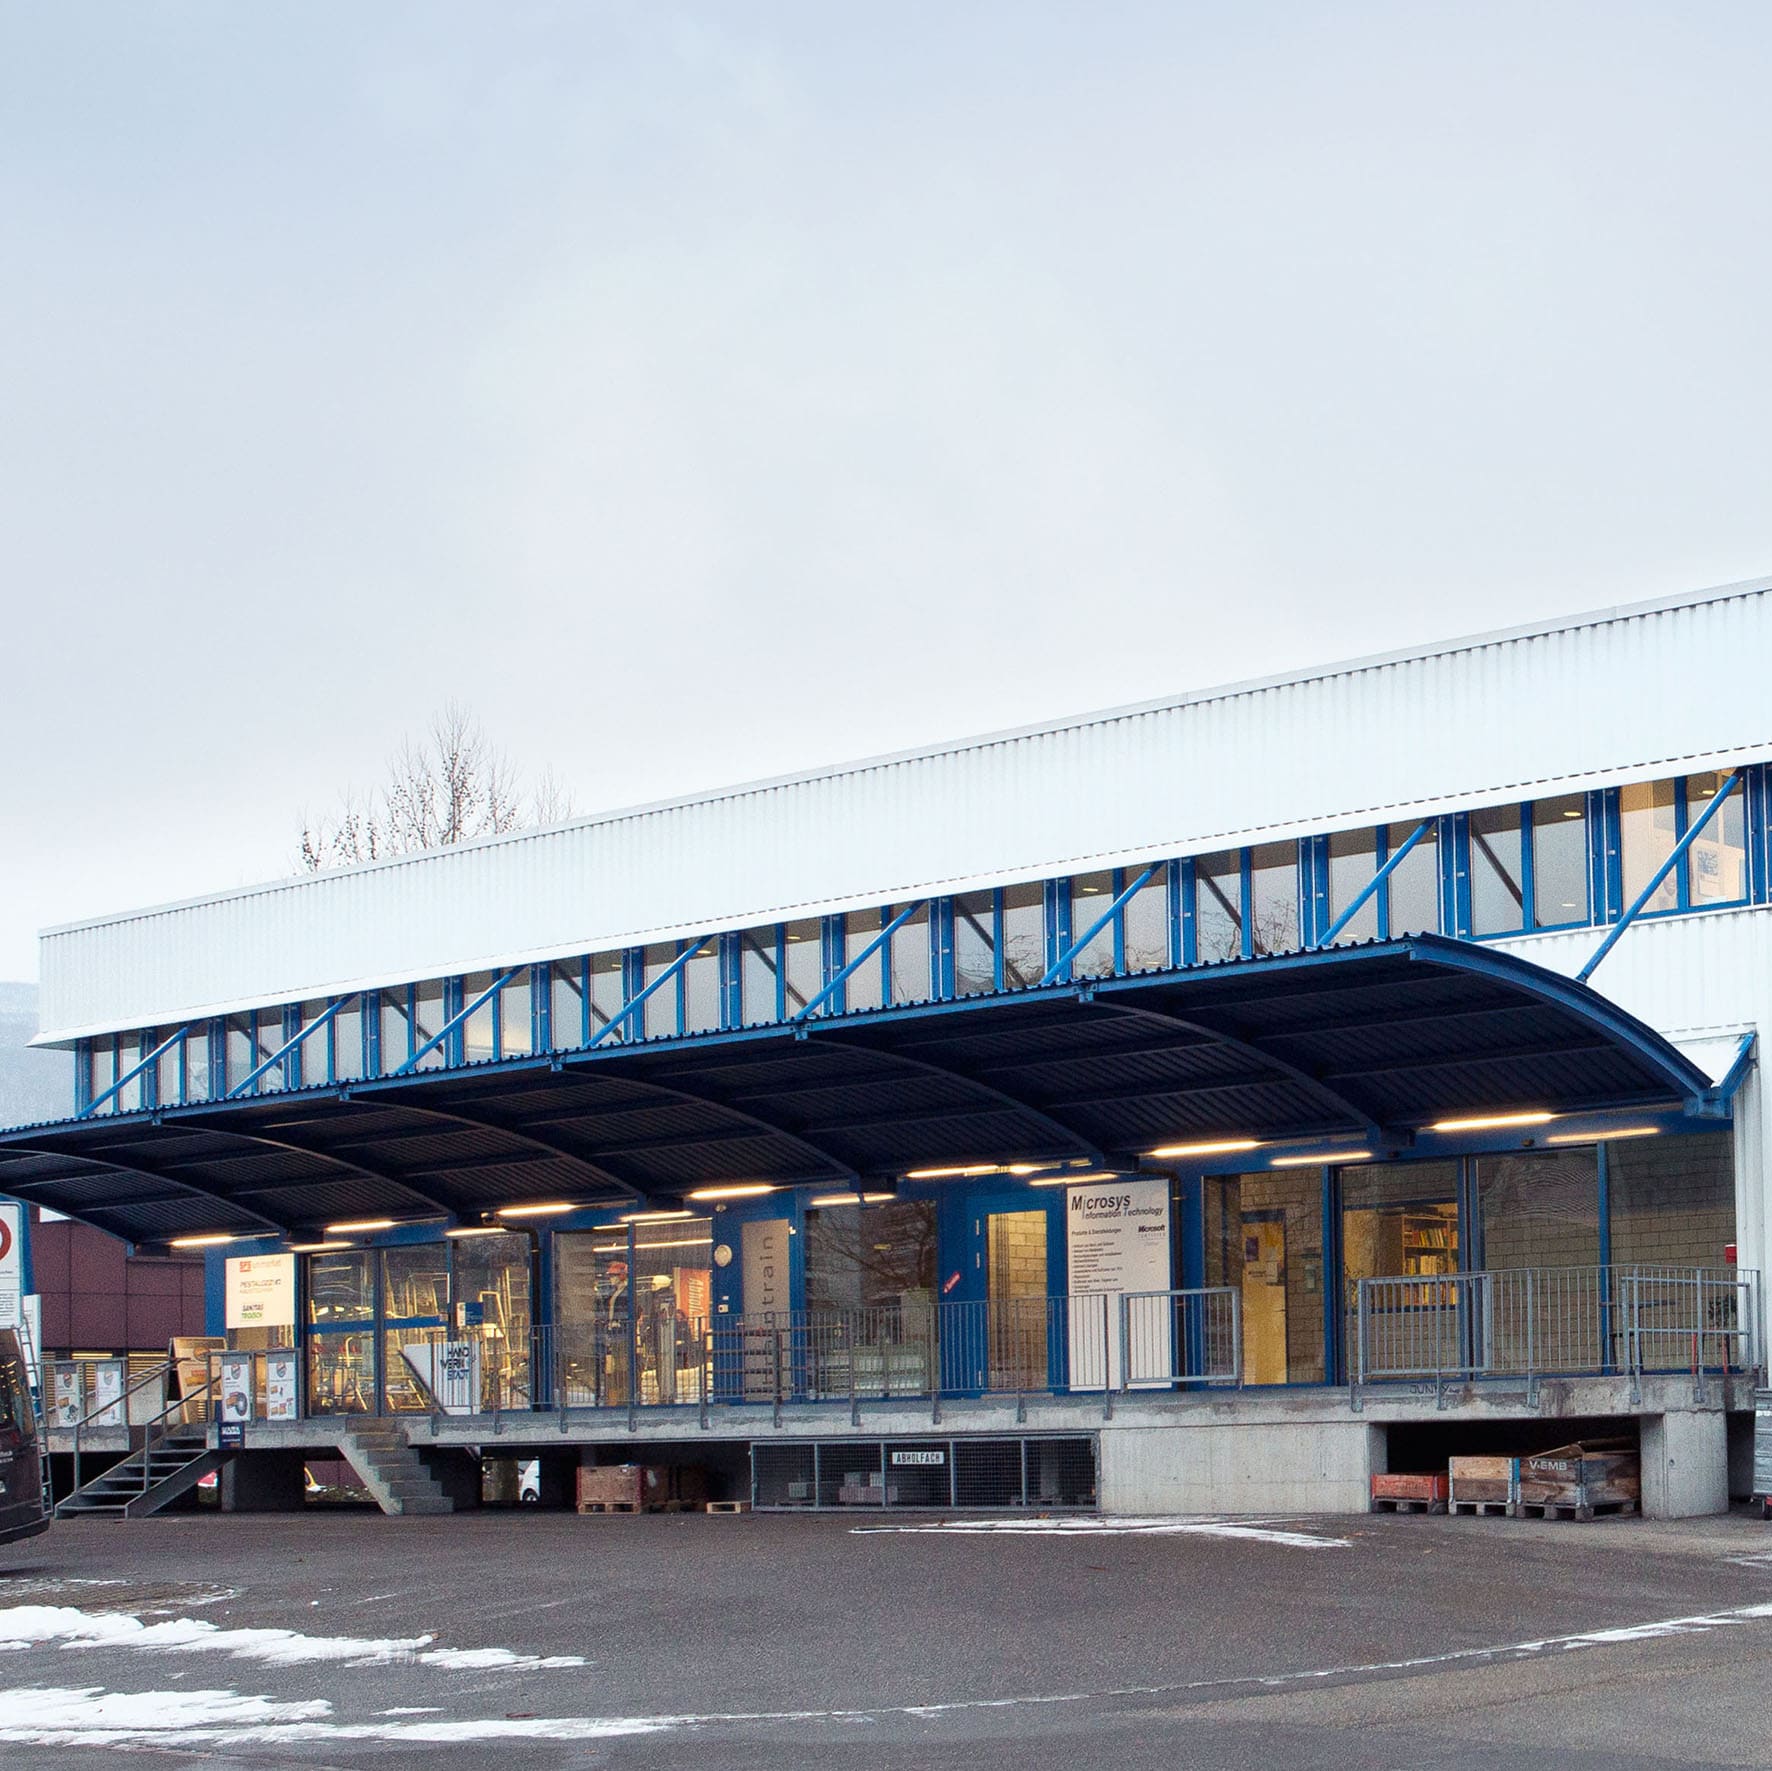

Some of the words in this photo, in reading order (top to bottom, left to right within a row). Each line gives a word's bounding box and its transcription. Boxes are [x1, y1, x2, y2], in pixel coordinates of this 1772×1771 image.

[1071, 1194, 1131, 1212] Microsys
[1123, 1206, 1164, 1217] Technology
[1138, 1224, 1166, 1233] Microsoft
[895, 1453, 941, 1463] ABHOLFACH
